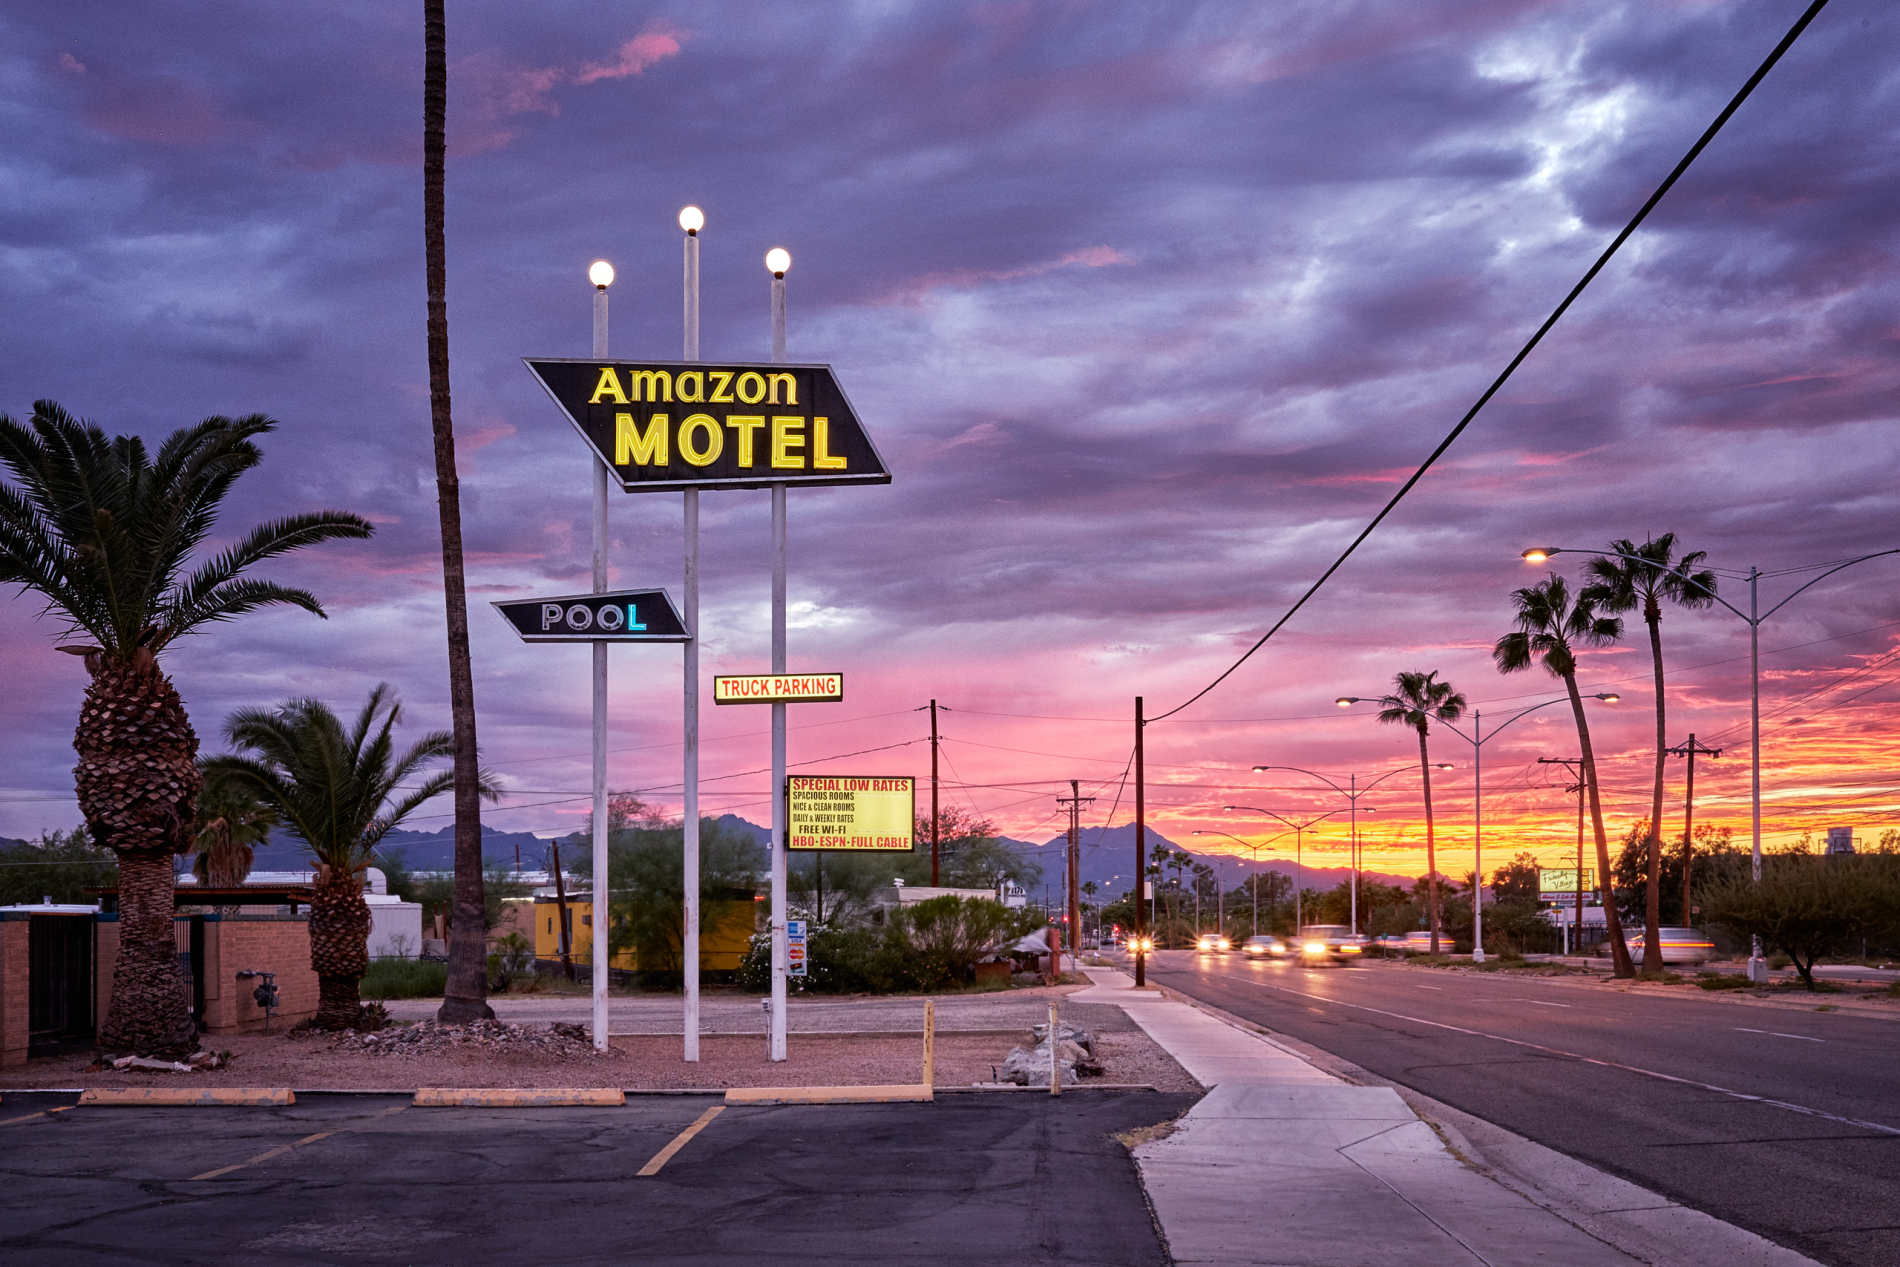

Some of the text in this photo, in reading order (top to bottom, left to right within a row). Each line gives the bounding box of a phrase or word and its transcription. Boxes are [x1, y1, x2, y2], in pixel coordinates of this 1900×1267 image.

[588, 367, 800, 405] Amazon
[615, 412, 848, 470] MOTEL
[541, 603, 647, 631] POOL
[722, 677, 836, 696] TRUCK PARKING
[793, 778, 908, 792] SPECIAL LOW RATES
[793, 791, 855, 801] SPACIOUS ROOMS
[793, 802, 855, 812] NICE & CLEAN ROOMS
[793, 813, 855, 823] DAILY & WEEKLY RATES
[799, 824, 847, 835] FREE WI-FI
[851, 837, 874, 848] FULL
[876, 837, 909, 849] CABLE
